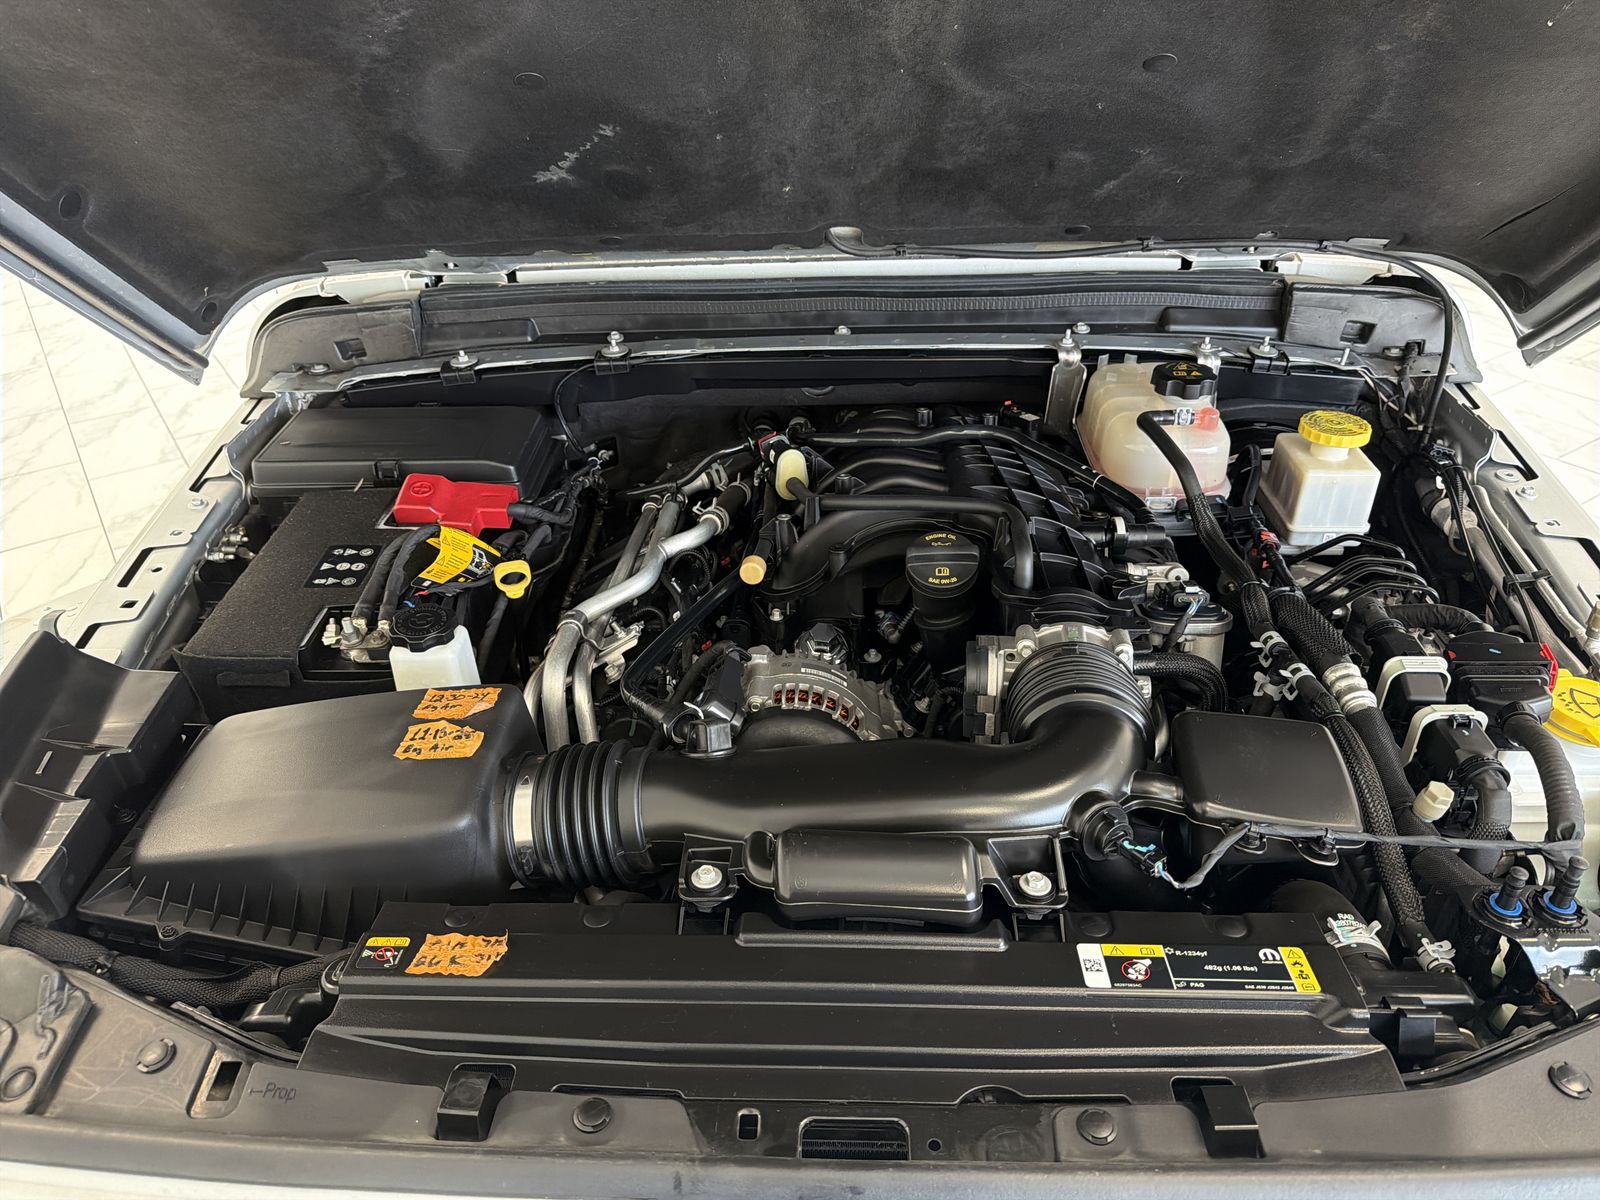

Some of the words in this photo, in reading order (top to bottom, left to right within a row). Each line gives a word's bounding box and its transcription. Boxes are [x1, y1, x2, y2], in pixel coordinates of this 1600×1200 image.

[925, 533, 947, 541] ENGINE
[940, 576, 958, 584] 0W-20
[1336, 912, 1355, 921] RAD
[262, 1081, 297, 1103] Prop
